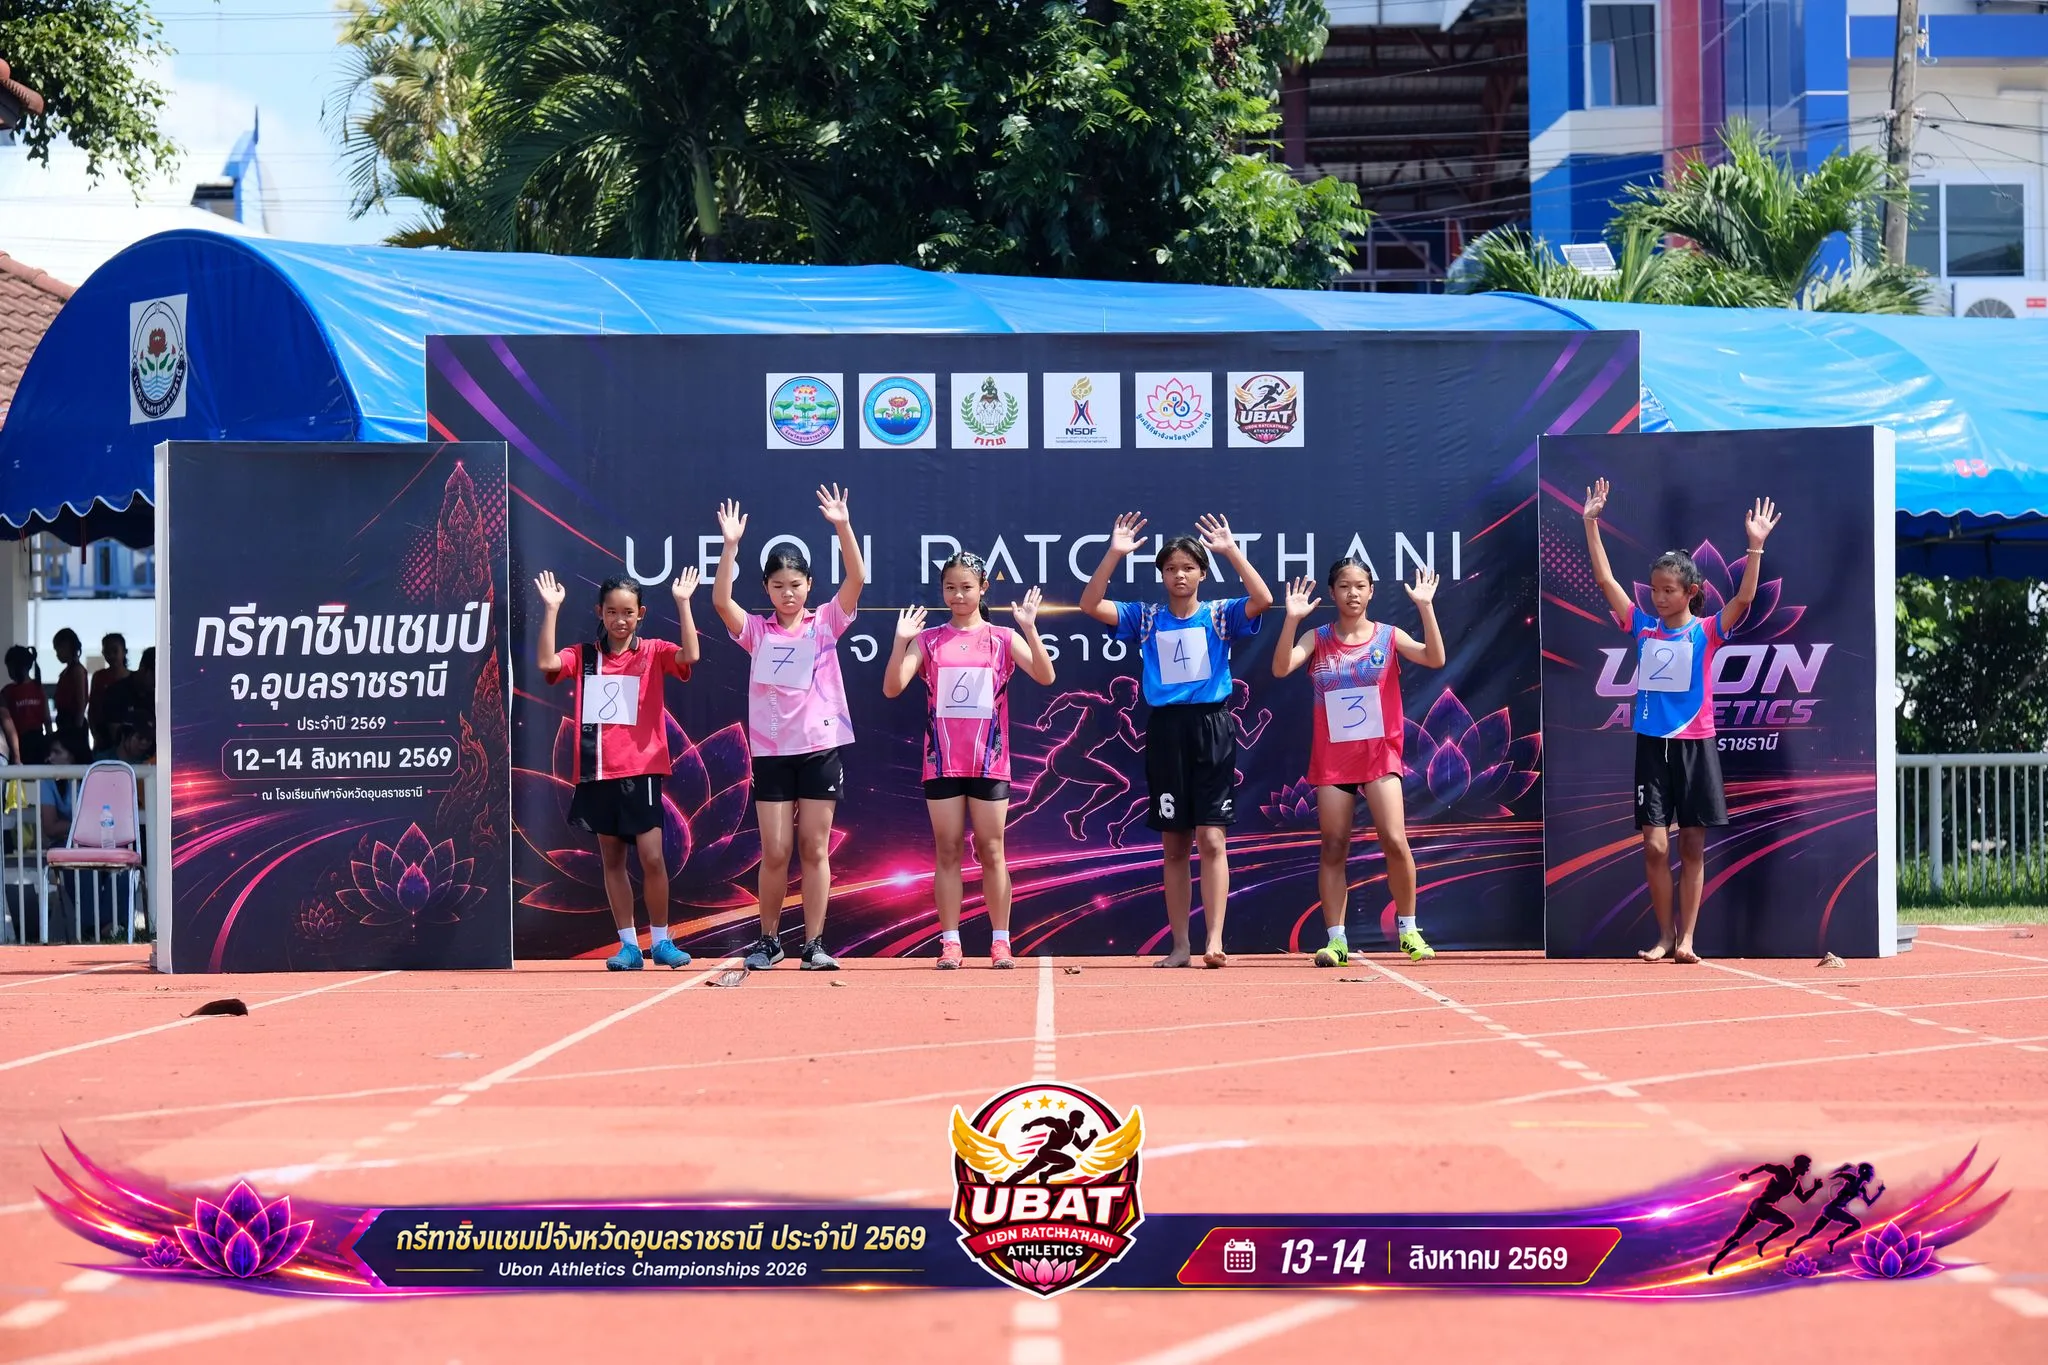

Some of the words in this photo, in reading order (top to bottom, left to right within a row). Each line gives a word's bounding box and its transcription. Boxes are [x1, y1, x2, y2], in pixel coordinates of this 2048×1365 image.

[1065, 427, 1097, 436] NSDF
[1240, 411, 1293, 424] UBAT
[626, 534, 872, 586] UBON
[772, 646, 795, 674] 7
[1173, 638, 1191, 670] 4
[1649, 647, 1674, 680] 2
[230, 660, 449, 711] จ.อุบลราชธานี
[1595, 643, 1833, 697] UON
[598, 681, 620, 720] 8
[951, 672, 969, 703] 6
[297, 714, 346, 731] ประจำปี
[350, 716, 387, 730] 2569
[1341, 695, 1367, 728] 3
[1600, 699, 1823, 730] AETICS
[311, 747, 391, 770] สิงหาคม
[399, 747, 452, 768] 2569
[261, 791, 273, 801] ณ
[1159, 792, 1175, 819] 6
